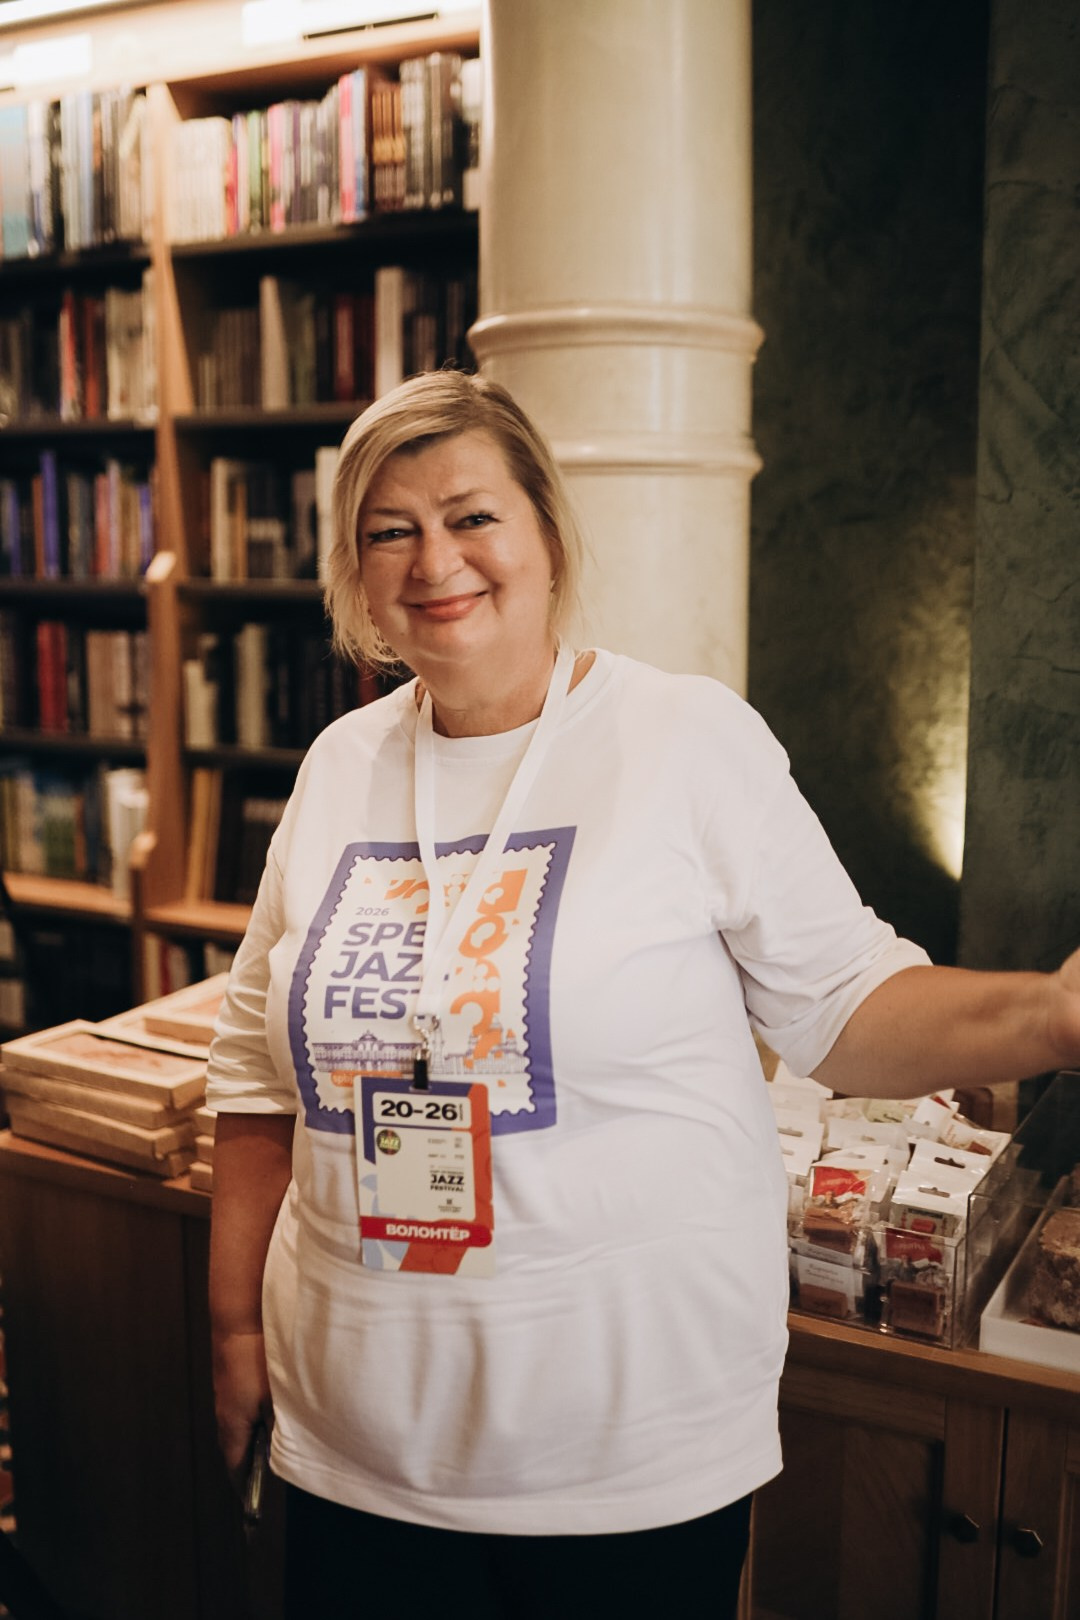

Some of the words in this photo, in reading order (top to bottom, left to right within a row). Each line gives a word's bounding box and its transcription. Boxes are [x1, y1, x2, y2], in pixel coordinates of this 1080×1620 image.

[355, 907, 390, 916] 2026
[330, 950, 449, 982] JAZ
[381, 1099, 457, 1121] 20-26
[430, 1174, 465, 1185] JAZZ
[430, 1184, 465, 1192] FESTIVAL
[386, 1223, 470, 1241] ВОЛОНТЁР
